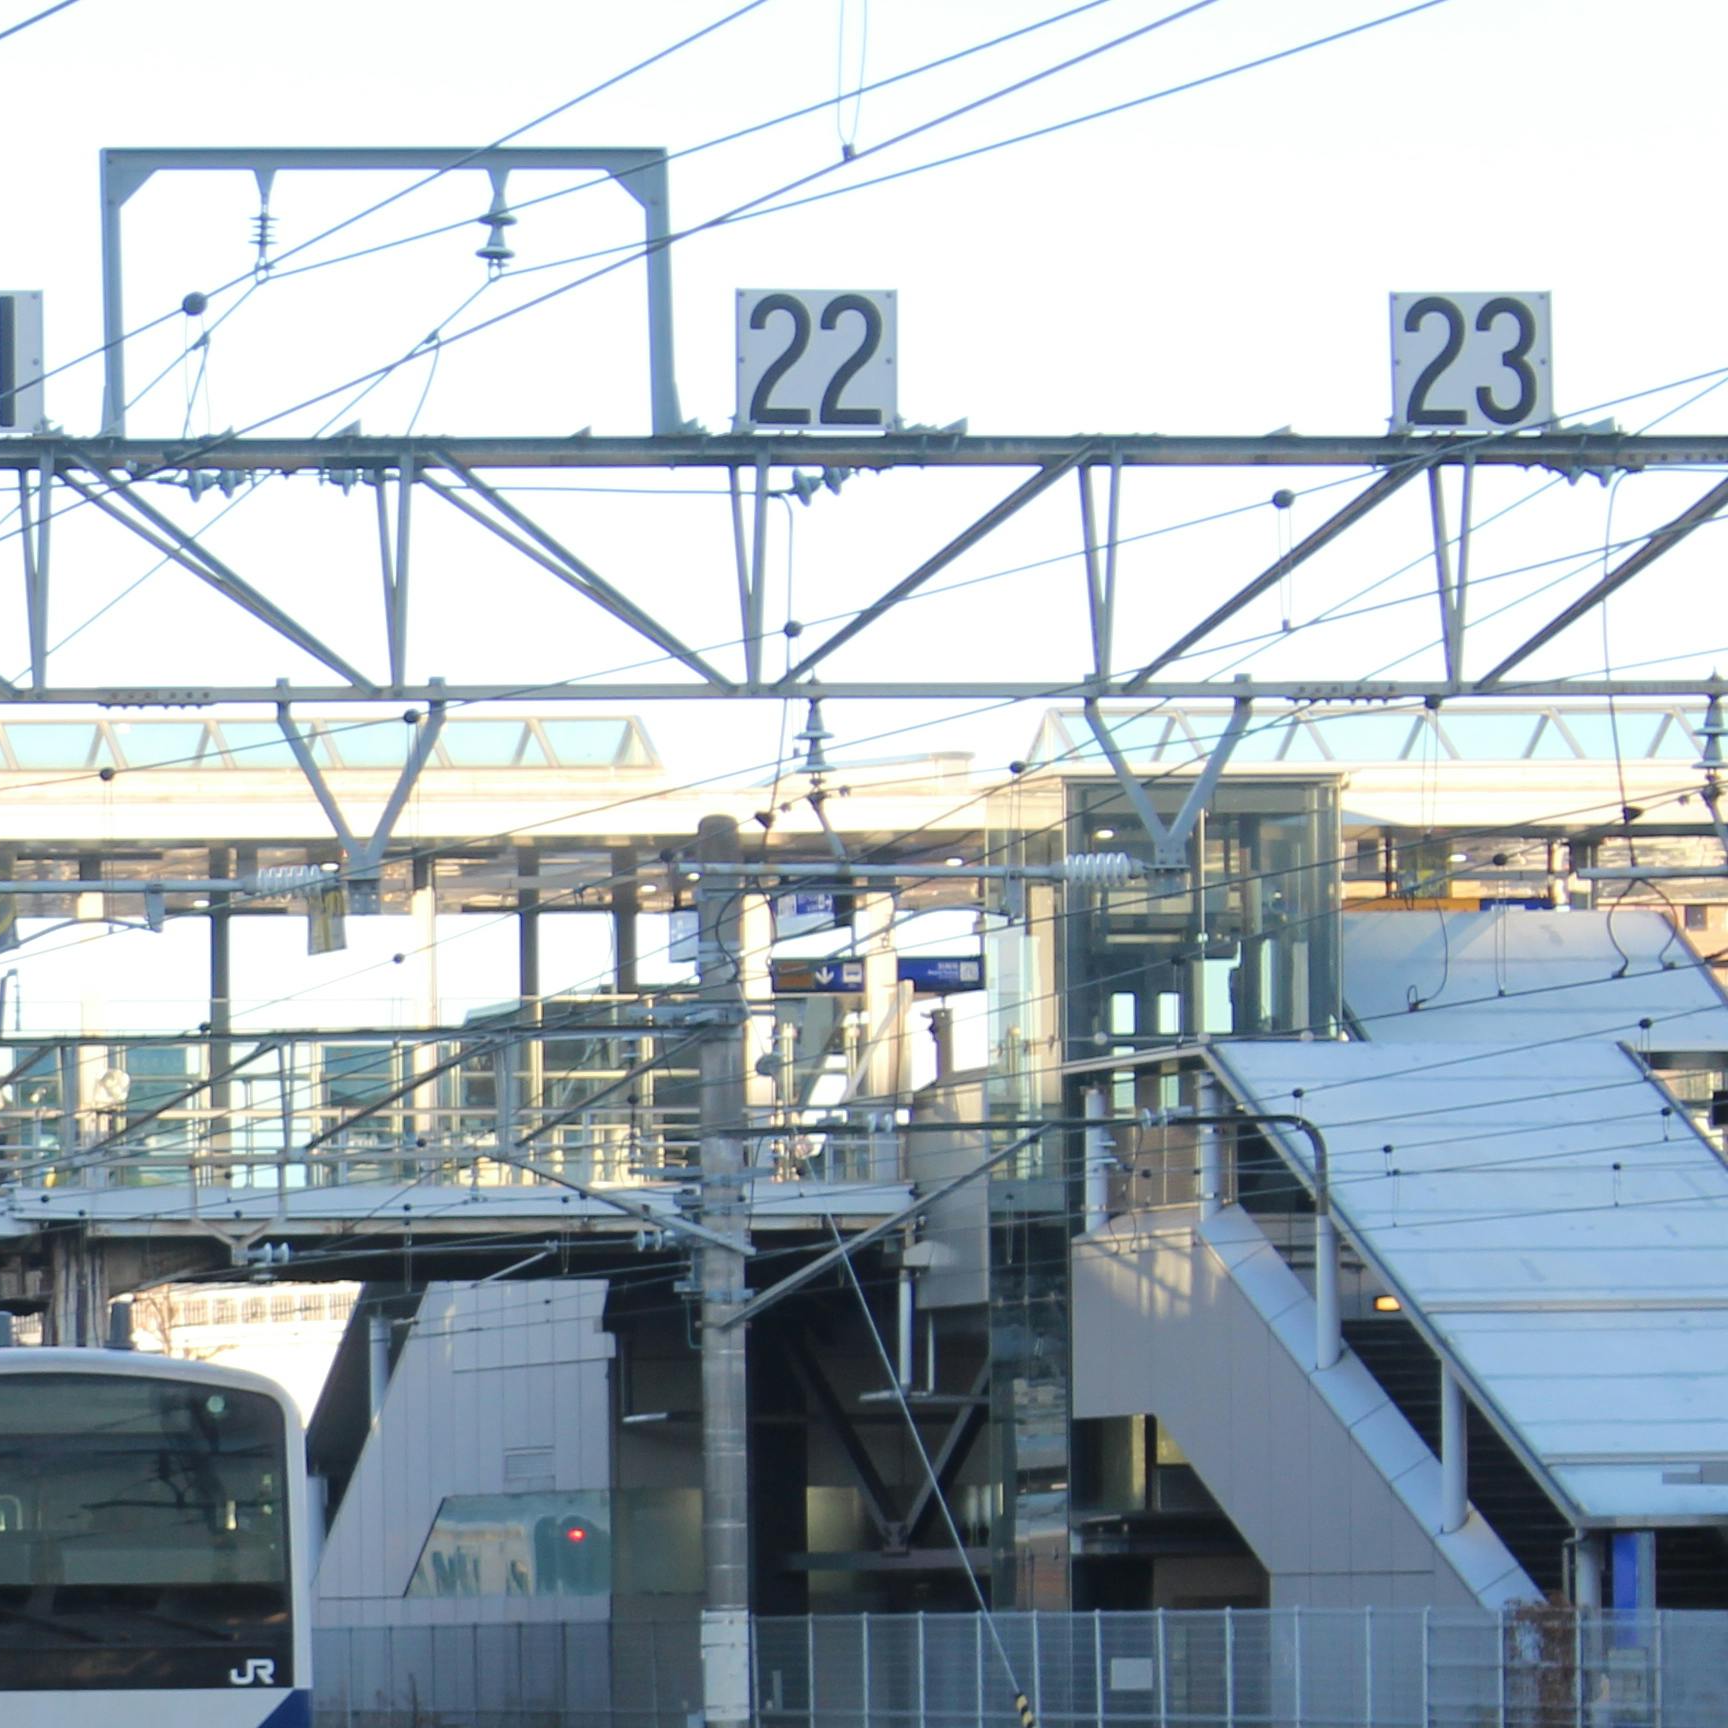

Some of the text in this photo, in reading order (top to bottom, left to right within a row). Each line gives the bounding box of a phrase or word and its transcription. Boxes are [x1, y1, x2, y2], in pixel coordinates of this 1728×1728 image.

[749, 293, 883, 425] 22
[1404, 296, 1537, 426] 23
[230, 1658, 275, 1685] JR
